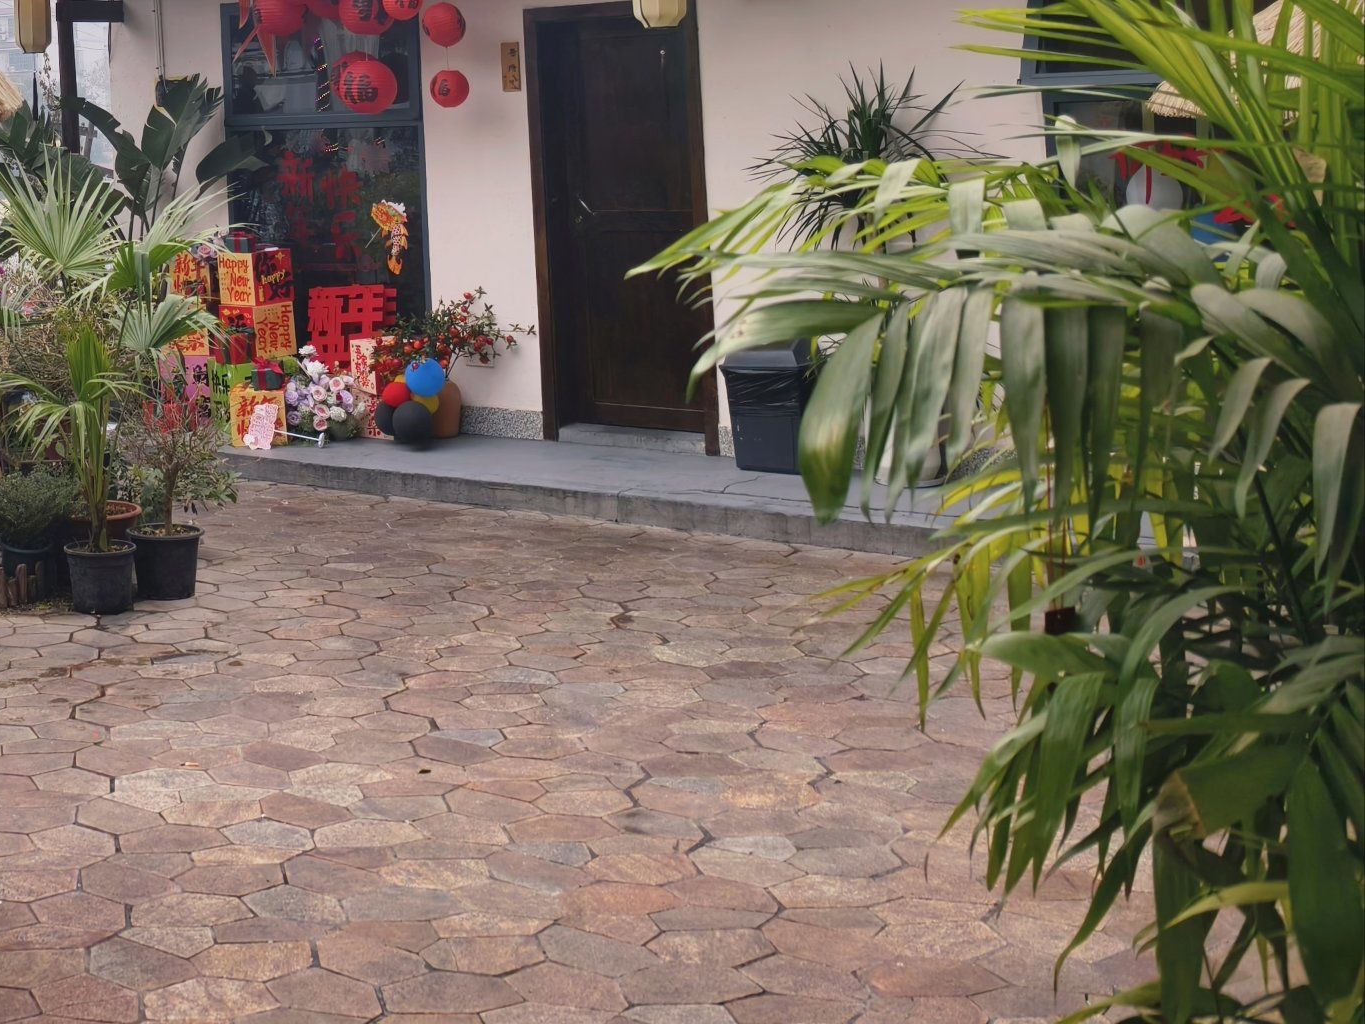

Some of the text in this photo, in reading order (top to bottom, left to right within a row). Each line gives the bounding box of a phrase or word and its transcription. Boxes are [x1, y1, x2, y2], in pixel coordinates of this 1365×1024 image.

[218, 255, 249, 273] Happy
[230, 273, 249, 287] New
[261, 269, 285, 285] happy
[227, 287, 251, 303] Year
[255, 316, 269, 353] Year
[269, 321, 280, 351] New
[279, 304, 292, 350] Happy
